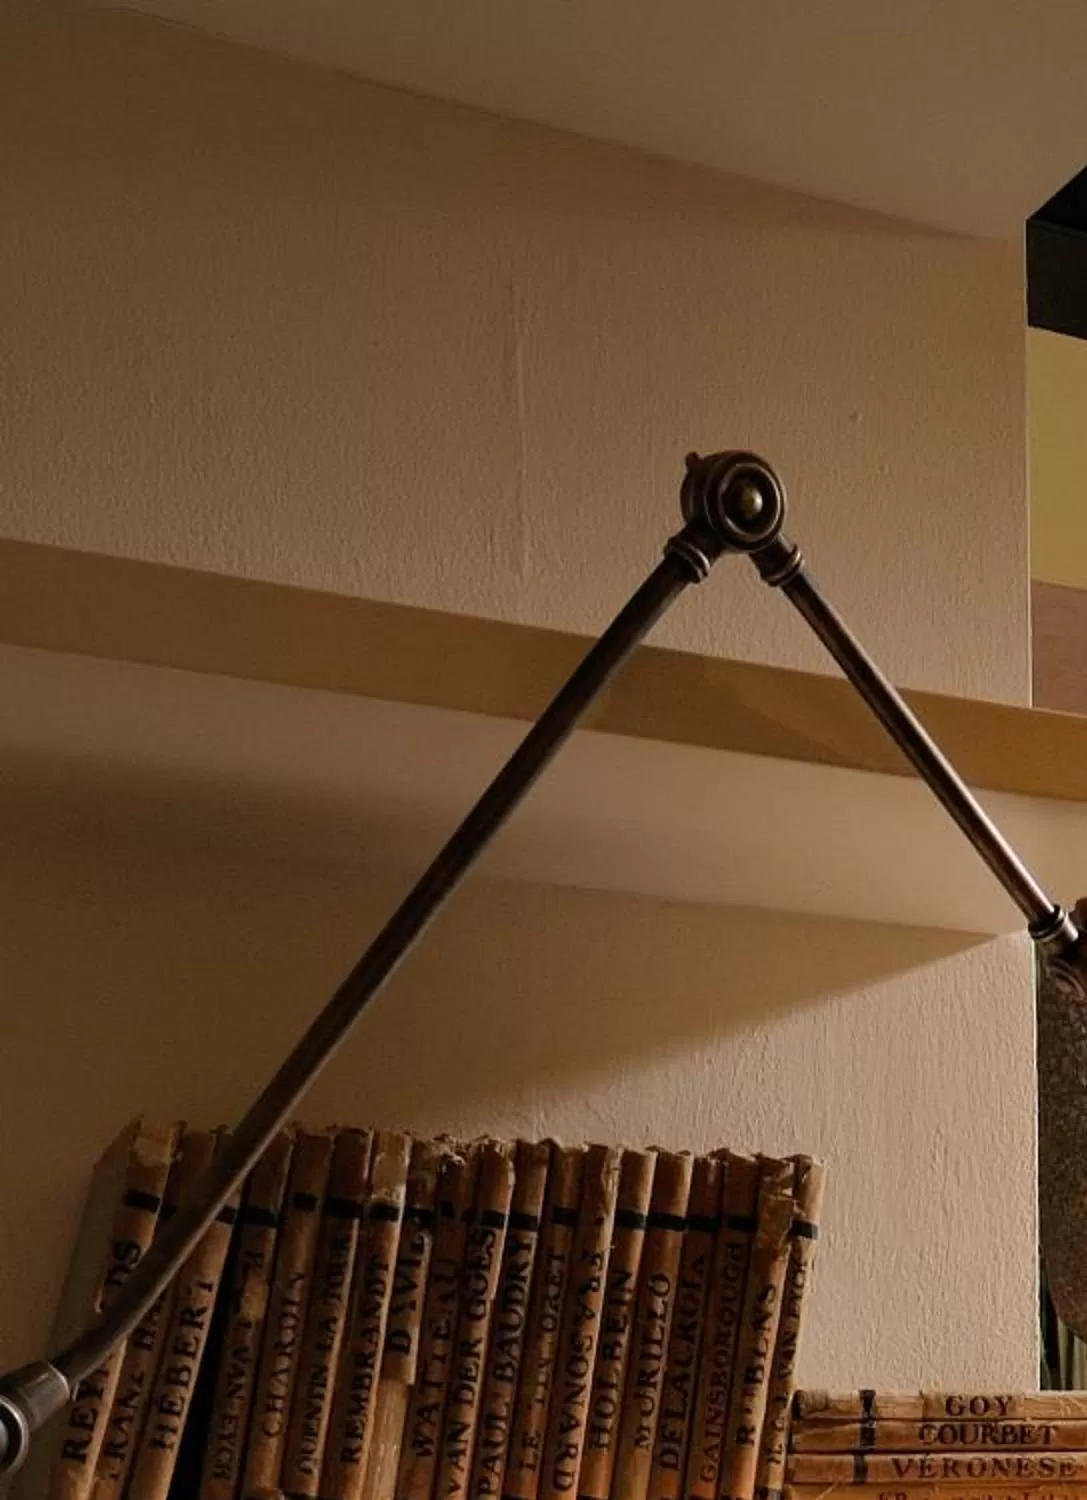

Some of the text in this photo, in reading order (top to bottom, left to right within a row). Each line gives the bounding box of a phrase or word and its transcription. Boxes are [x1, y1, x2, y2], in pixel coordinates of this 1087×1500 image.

[61, 1241, 141, 1462] REYDS
[263, 1271, 307, 1437] CHARDIN
[339, 1254, 390, 1463] REMBRANDT
[447, 1229, 497, 1494] VAN DER GOES
[479, 1241, 534, 1496] PAUL BAUDRY
[519, 1430, 542, 1470] LE
[554, 1250, 605, 1490] FRAGONARD
[590, 1269, 633, 1450] HOLBEIN
[635, 1273, 672, 1449] MURILLO
[700, 1243, 741, 1482] GAINSBOROUGH
[918, 1422, 1058, 1446] COURBET
